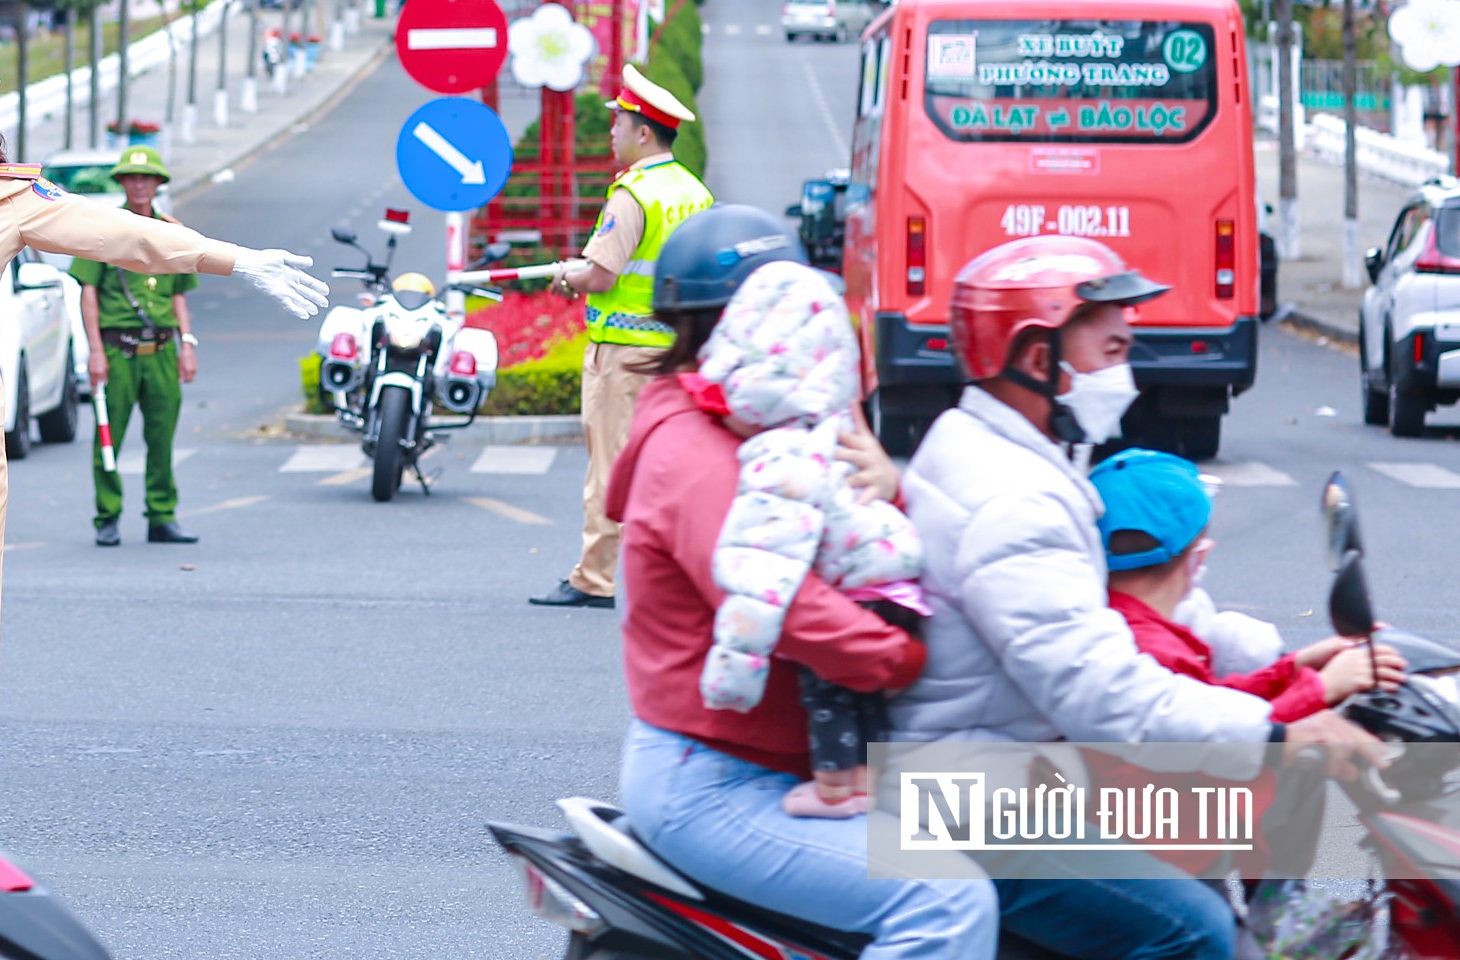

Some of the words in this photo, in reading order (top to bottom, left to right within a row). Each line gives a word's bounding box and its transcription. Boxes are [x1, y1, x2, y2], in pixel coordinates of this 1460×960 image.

[1017, 34, 1054, 57] XE
[1170, 35, 1202, 67] 02
[1081, 63, 1170, 87] TRANG
[952, 102, 987, 129] ĐÀ
[993, 107, 1039, 135] LẠT
[1078, 100, 1133, 129] BẢO
[1136, 103, 1187, 136] LỘC
